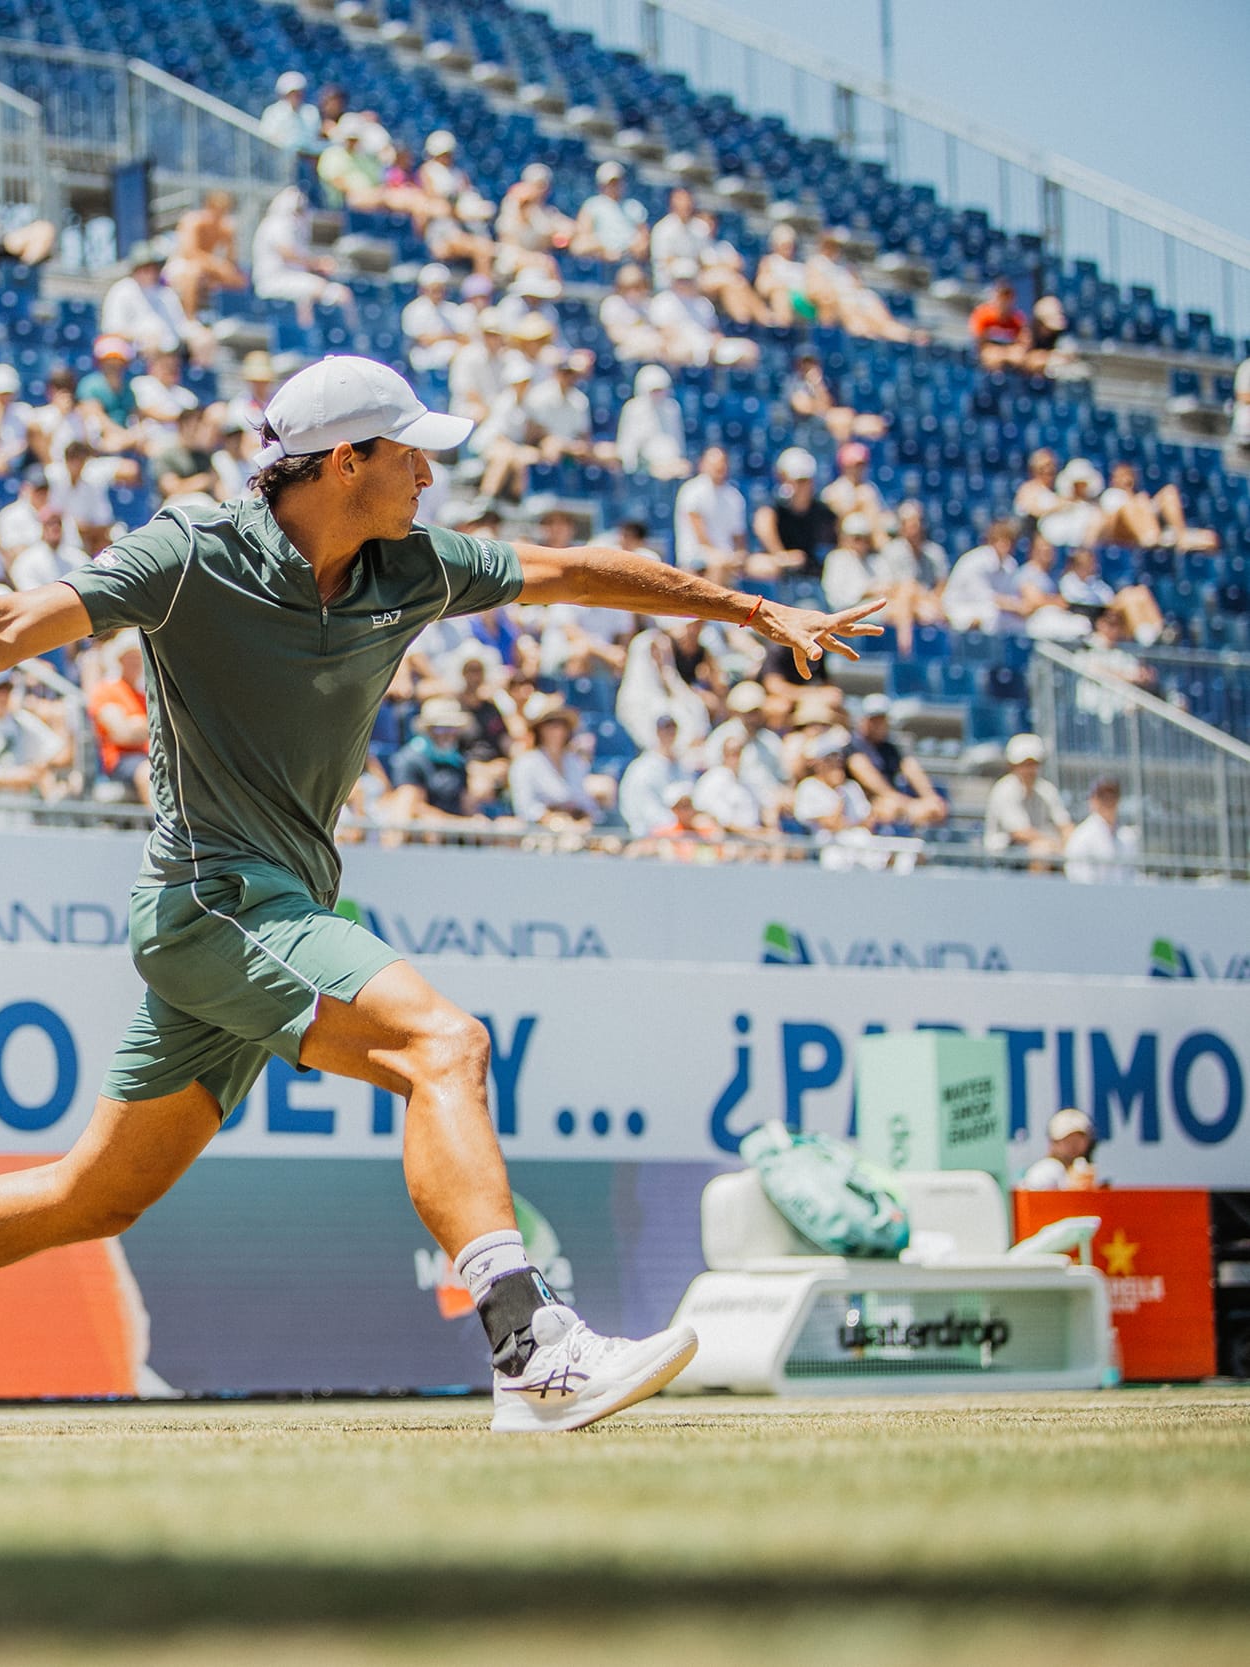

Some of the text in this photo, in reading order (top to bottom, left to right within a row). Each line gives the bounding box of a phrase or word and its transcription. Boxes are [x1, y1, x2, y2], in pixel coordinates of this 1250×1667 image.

[395, 912, 611, 958] VANDA
[709, 1012, 1244, 1153] ¿PTIMO
[839, 1313, 1010, 1357] waterdrop
